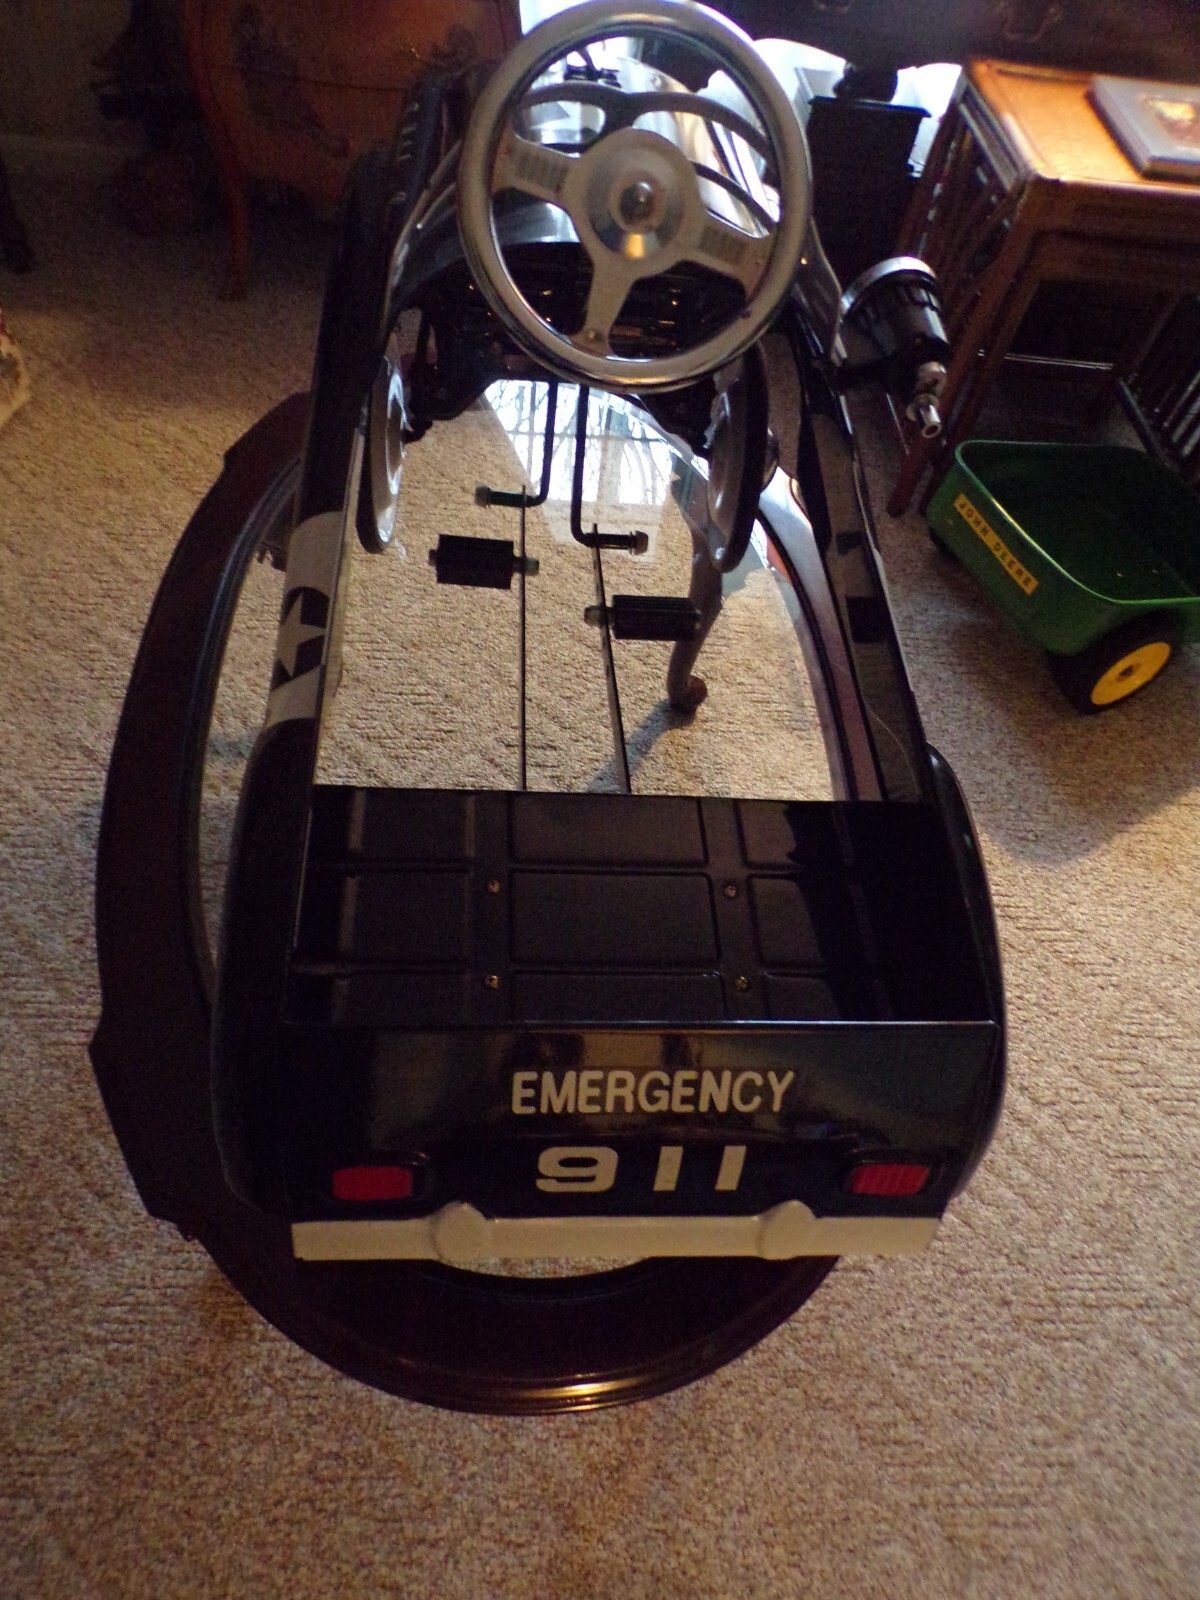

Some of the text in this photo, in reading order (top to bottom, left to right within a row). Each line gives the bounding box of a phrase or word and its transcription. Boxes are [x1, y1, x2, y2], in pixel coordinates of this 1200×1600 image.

[958, 502, 1033, 587] JOHN DEERE
[512, 1070, 795, 1115] EMERGENCY
[535, 1145, 747, 1193] 911
